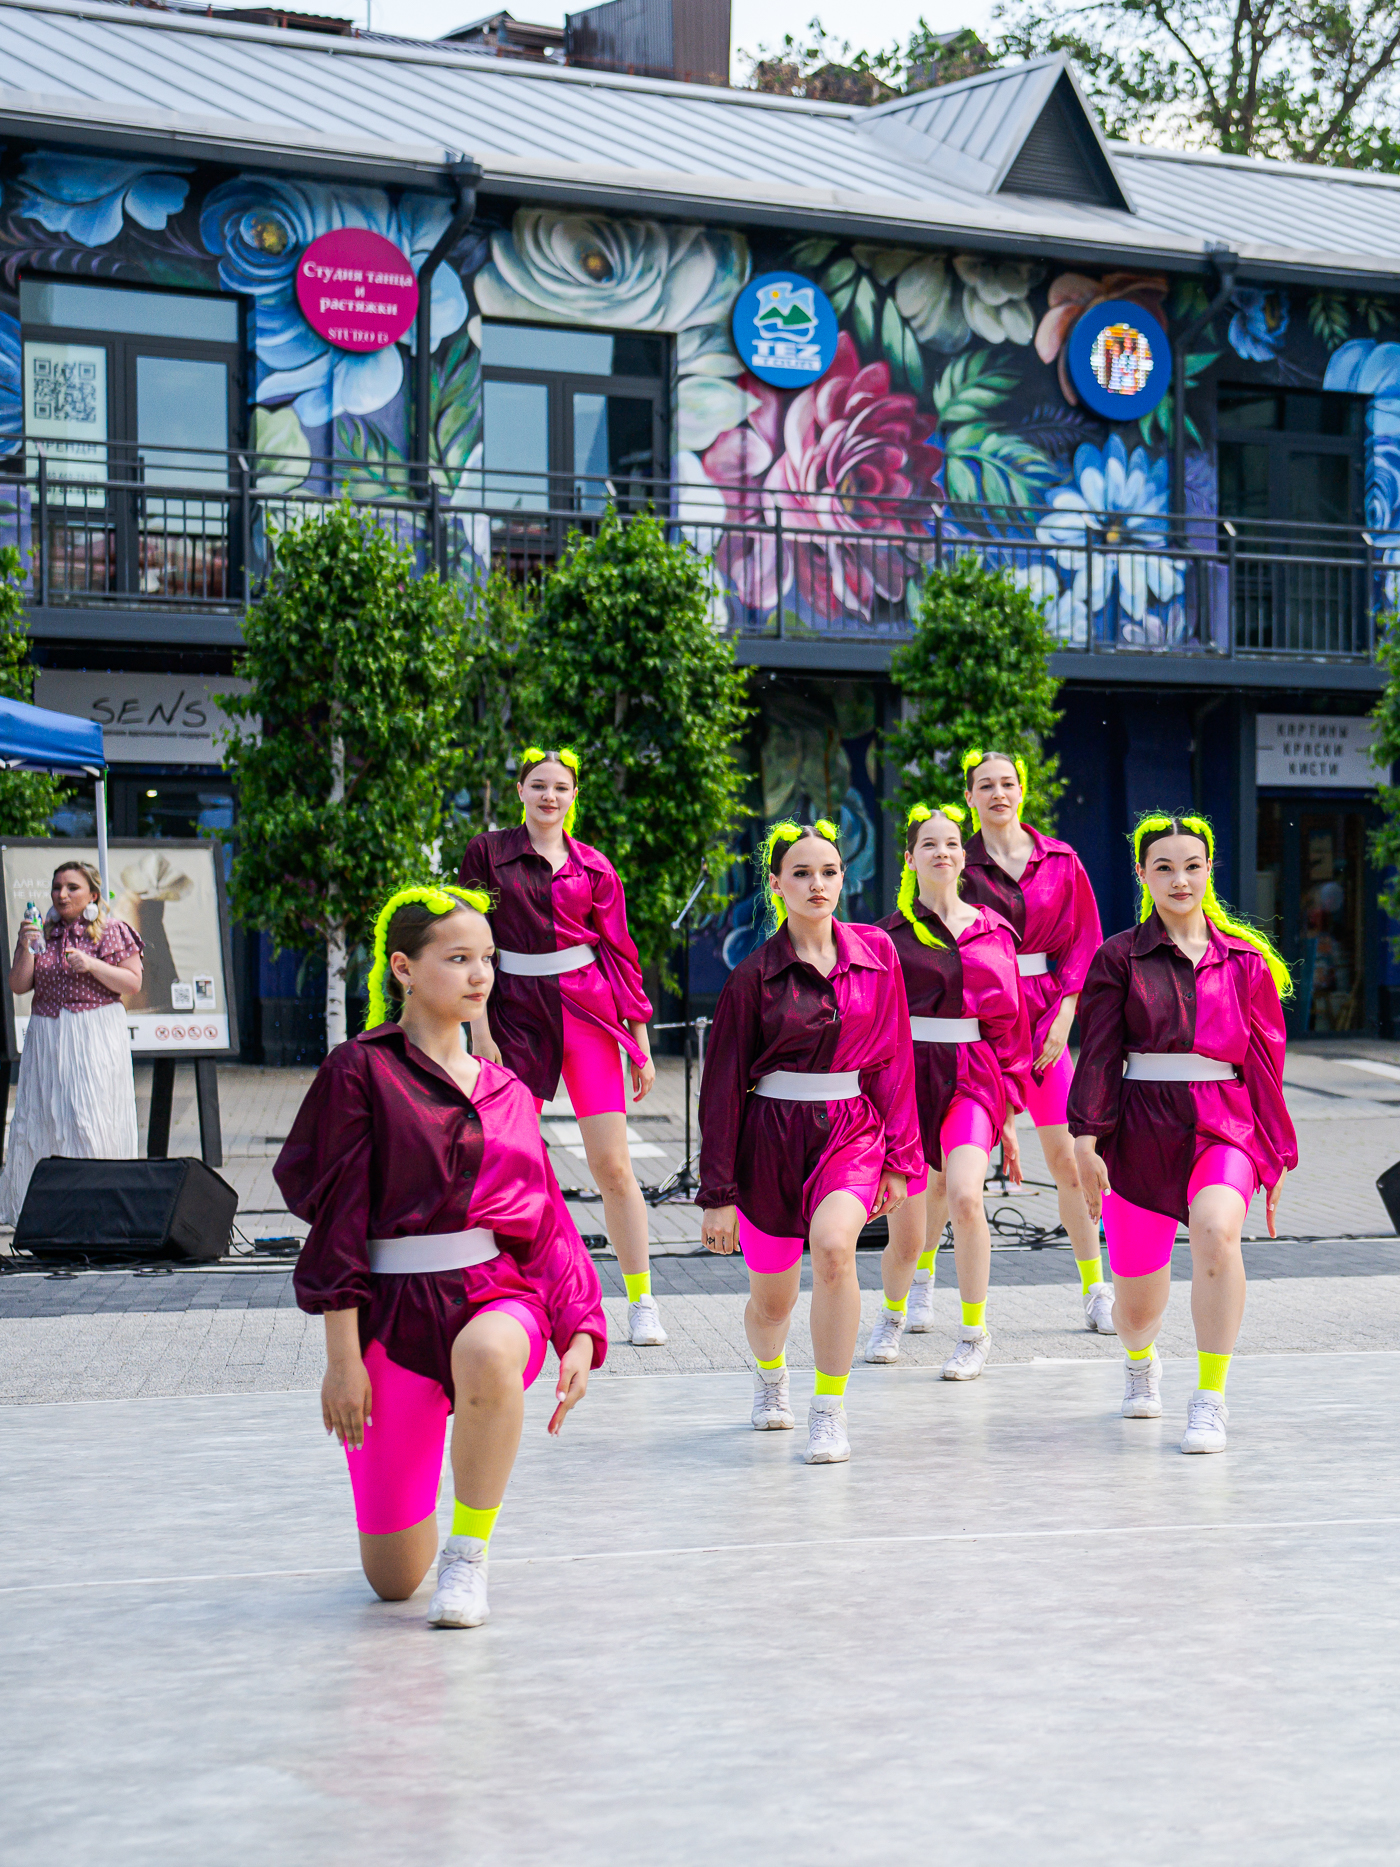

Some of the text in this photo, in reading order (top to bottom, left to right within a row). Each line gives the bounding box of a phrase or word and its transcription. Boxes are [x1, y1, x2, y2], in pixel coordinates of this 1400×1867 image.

[302, 260, 413, 288] Студия танца
[354, 285, 366, 298] и
[319, 296, 398, 316] растяжки
[751, 339, 821, 360] TEZ
[89, 689, 208, 728] SENS
[1277, 723, 1348, 738] КАРТИНЫ
[1283, 742, 1343, 757] КРАСКИ
[1288, 761, 1338, 777] КИСТИ
